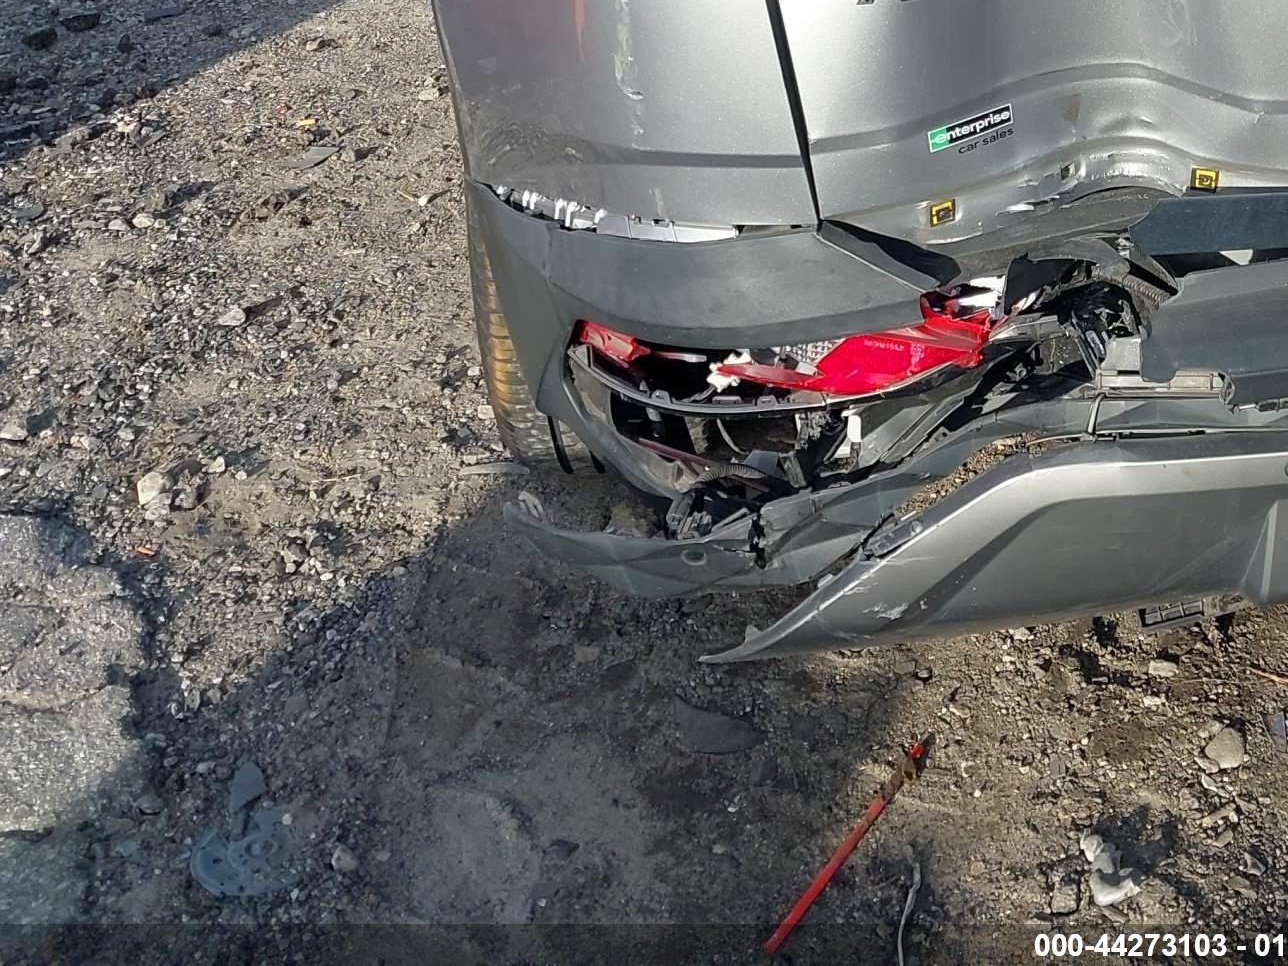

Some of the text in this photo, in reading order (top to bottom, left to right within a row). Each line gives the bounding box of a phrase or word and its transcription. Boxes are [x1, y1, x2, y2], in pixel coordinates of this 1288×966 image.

[931, 111, 1011, 144] enterprise
[958, 128, 1014, 154] car sales
